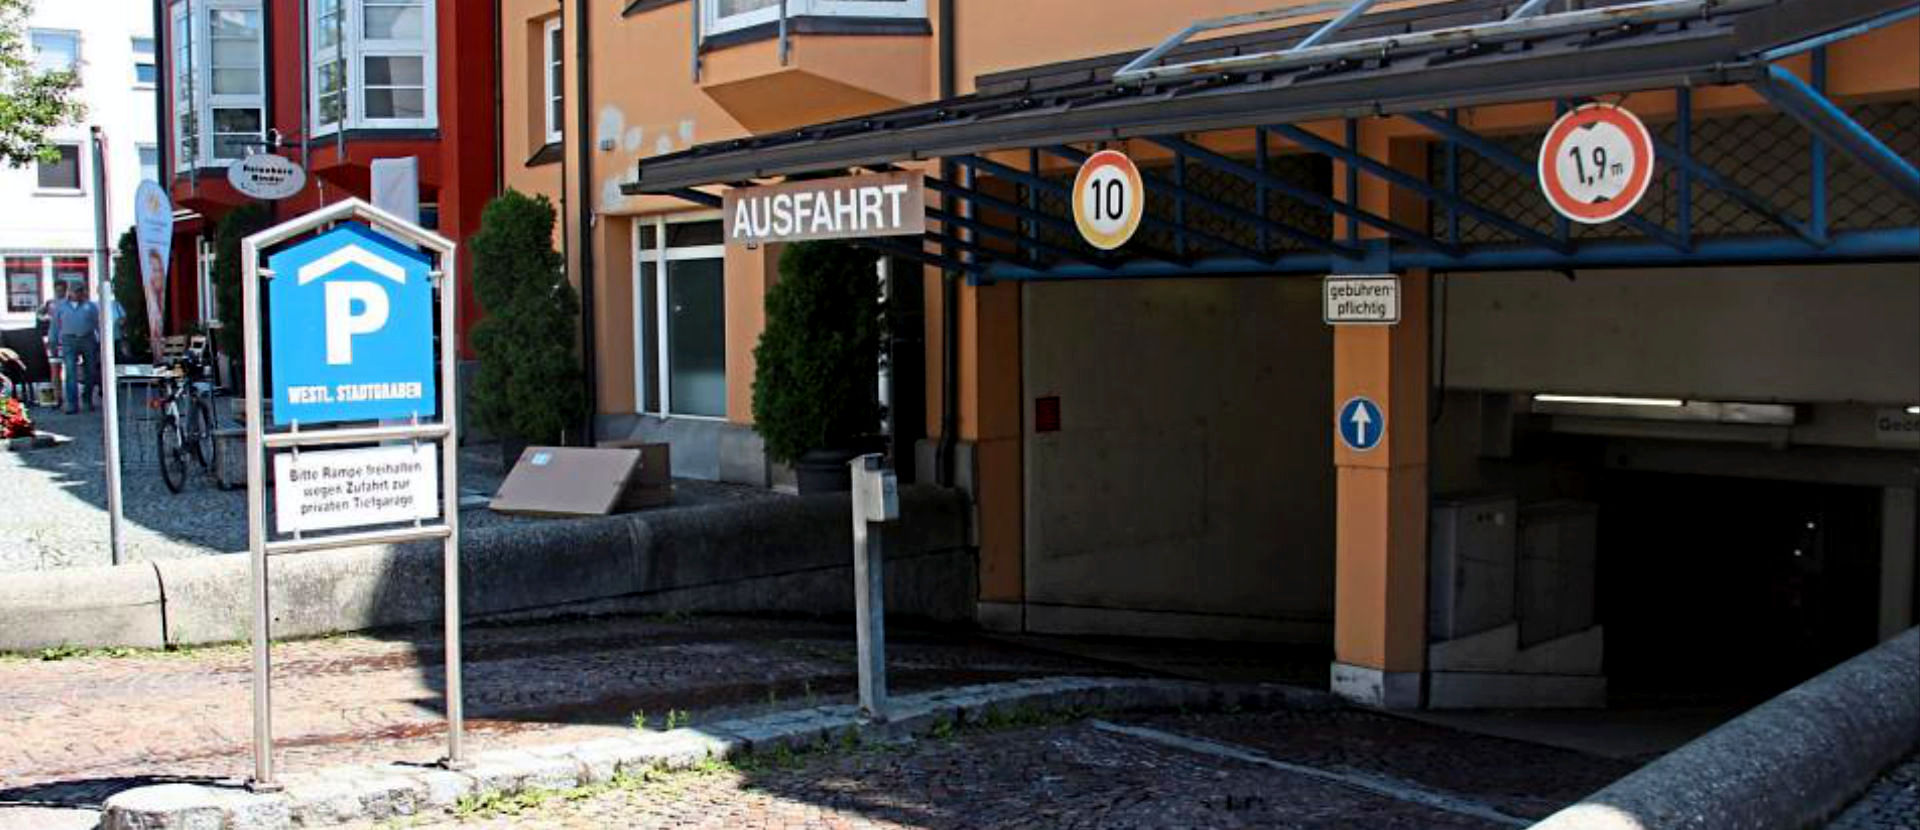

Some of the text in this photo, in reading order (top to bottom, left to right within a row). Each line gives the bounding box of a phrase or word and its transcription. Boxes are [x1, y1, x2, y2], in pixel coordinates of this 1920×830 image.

[1569, 146, 1607, 186] 1,9
[1091, 178, 1124, 220] 10
[732, 184, 909, 239] AUSFAHRT
[1338, 301, 1387, 318] pflichtig
[324, 281, 391, 366] P
[336, 381, 422, 402] STADTGRABEN
[289, 462, 422, 482] Bitte Rampe freihalten
[303, 479, 411, 499] wegen Zufahrt zur
[301, 495, 414, 516] privaten Tiefgarage
